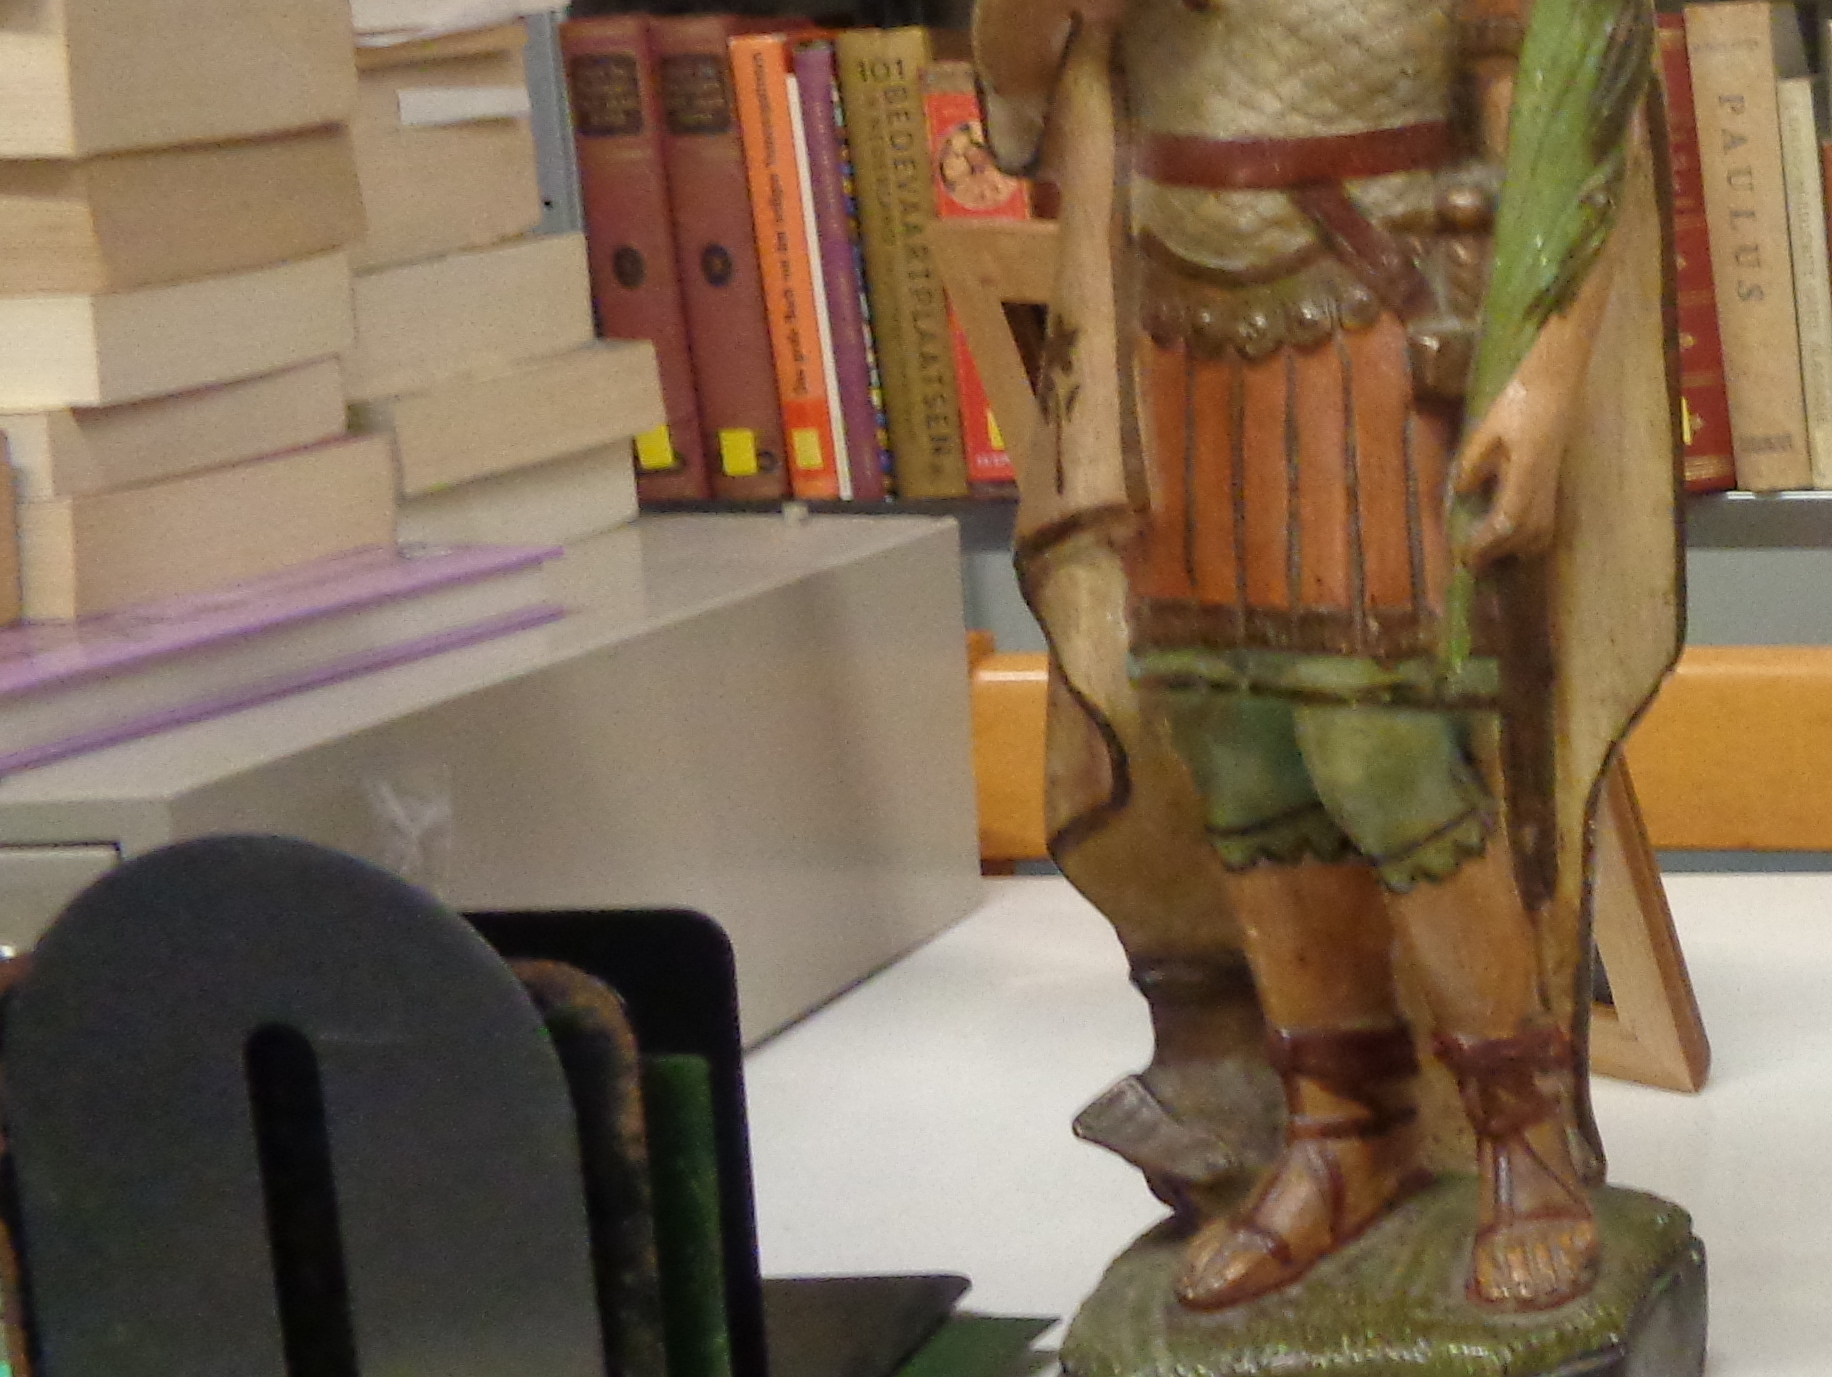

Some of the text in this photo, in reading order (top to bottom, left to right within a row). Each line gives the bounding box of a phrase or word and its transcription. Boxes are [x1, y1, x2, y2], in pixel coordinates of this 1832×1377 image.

[858, 59, 905, 82] 101
[883, 86, 952, 457] BEDEVAARTPLAATSEN
[1718, 94, 1763, 303] PAULUS
